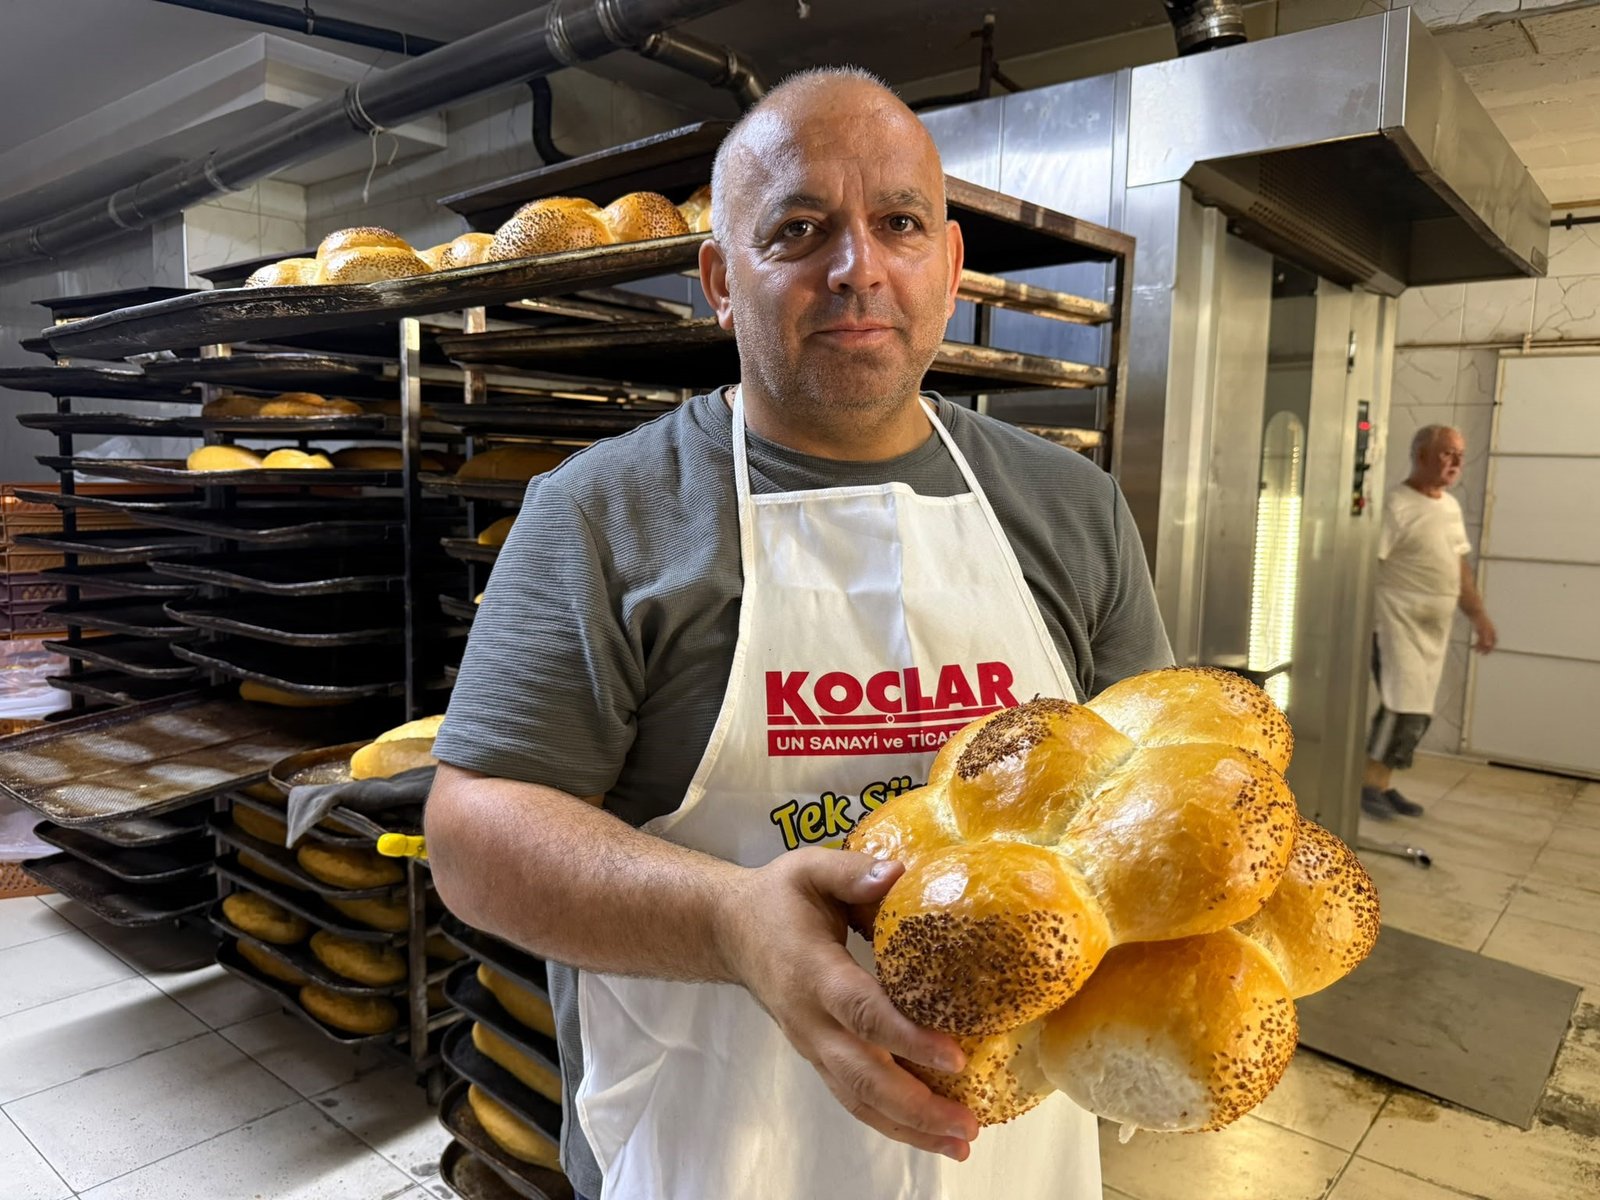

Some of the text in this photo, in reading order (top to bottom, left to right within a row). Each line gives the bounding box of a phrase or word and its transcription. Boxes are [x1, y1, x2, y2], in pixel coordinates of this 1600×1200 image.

[776, 736, 805, 750] UN
[809, 732, 879, 750] SANAYİ
[883, 737, 903, 749] ve
[770, 791, 855, 850] Tek
